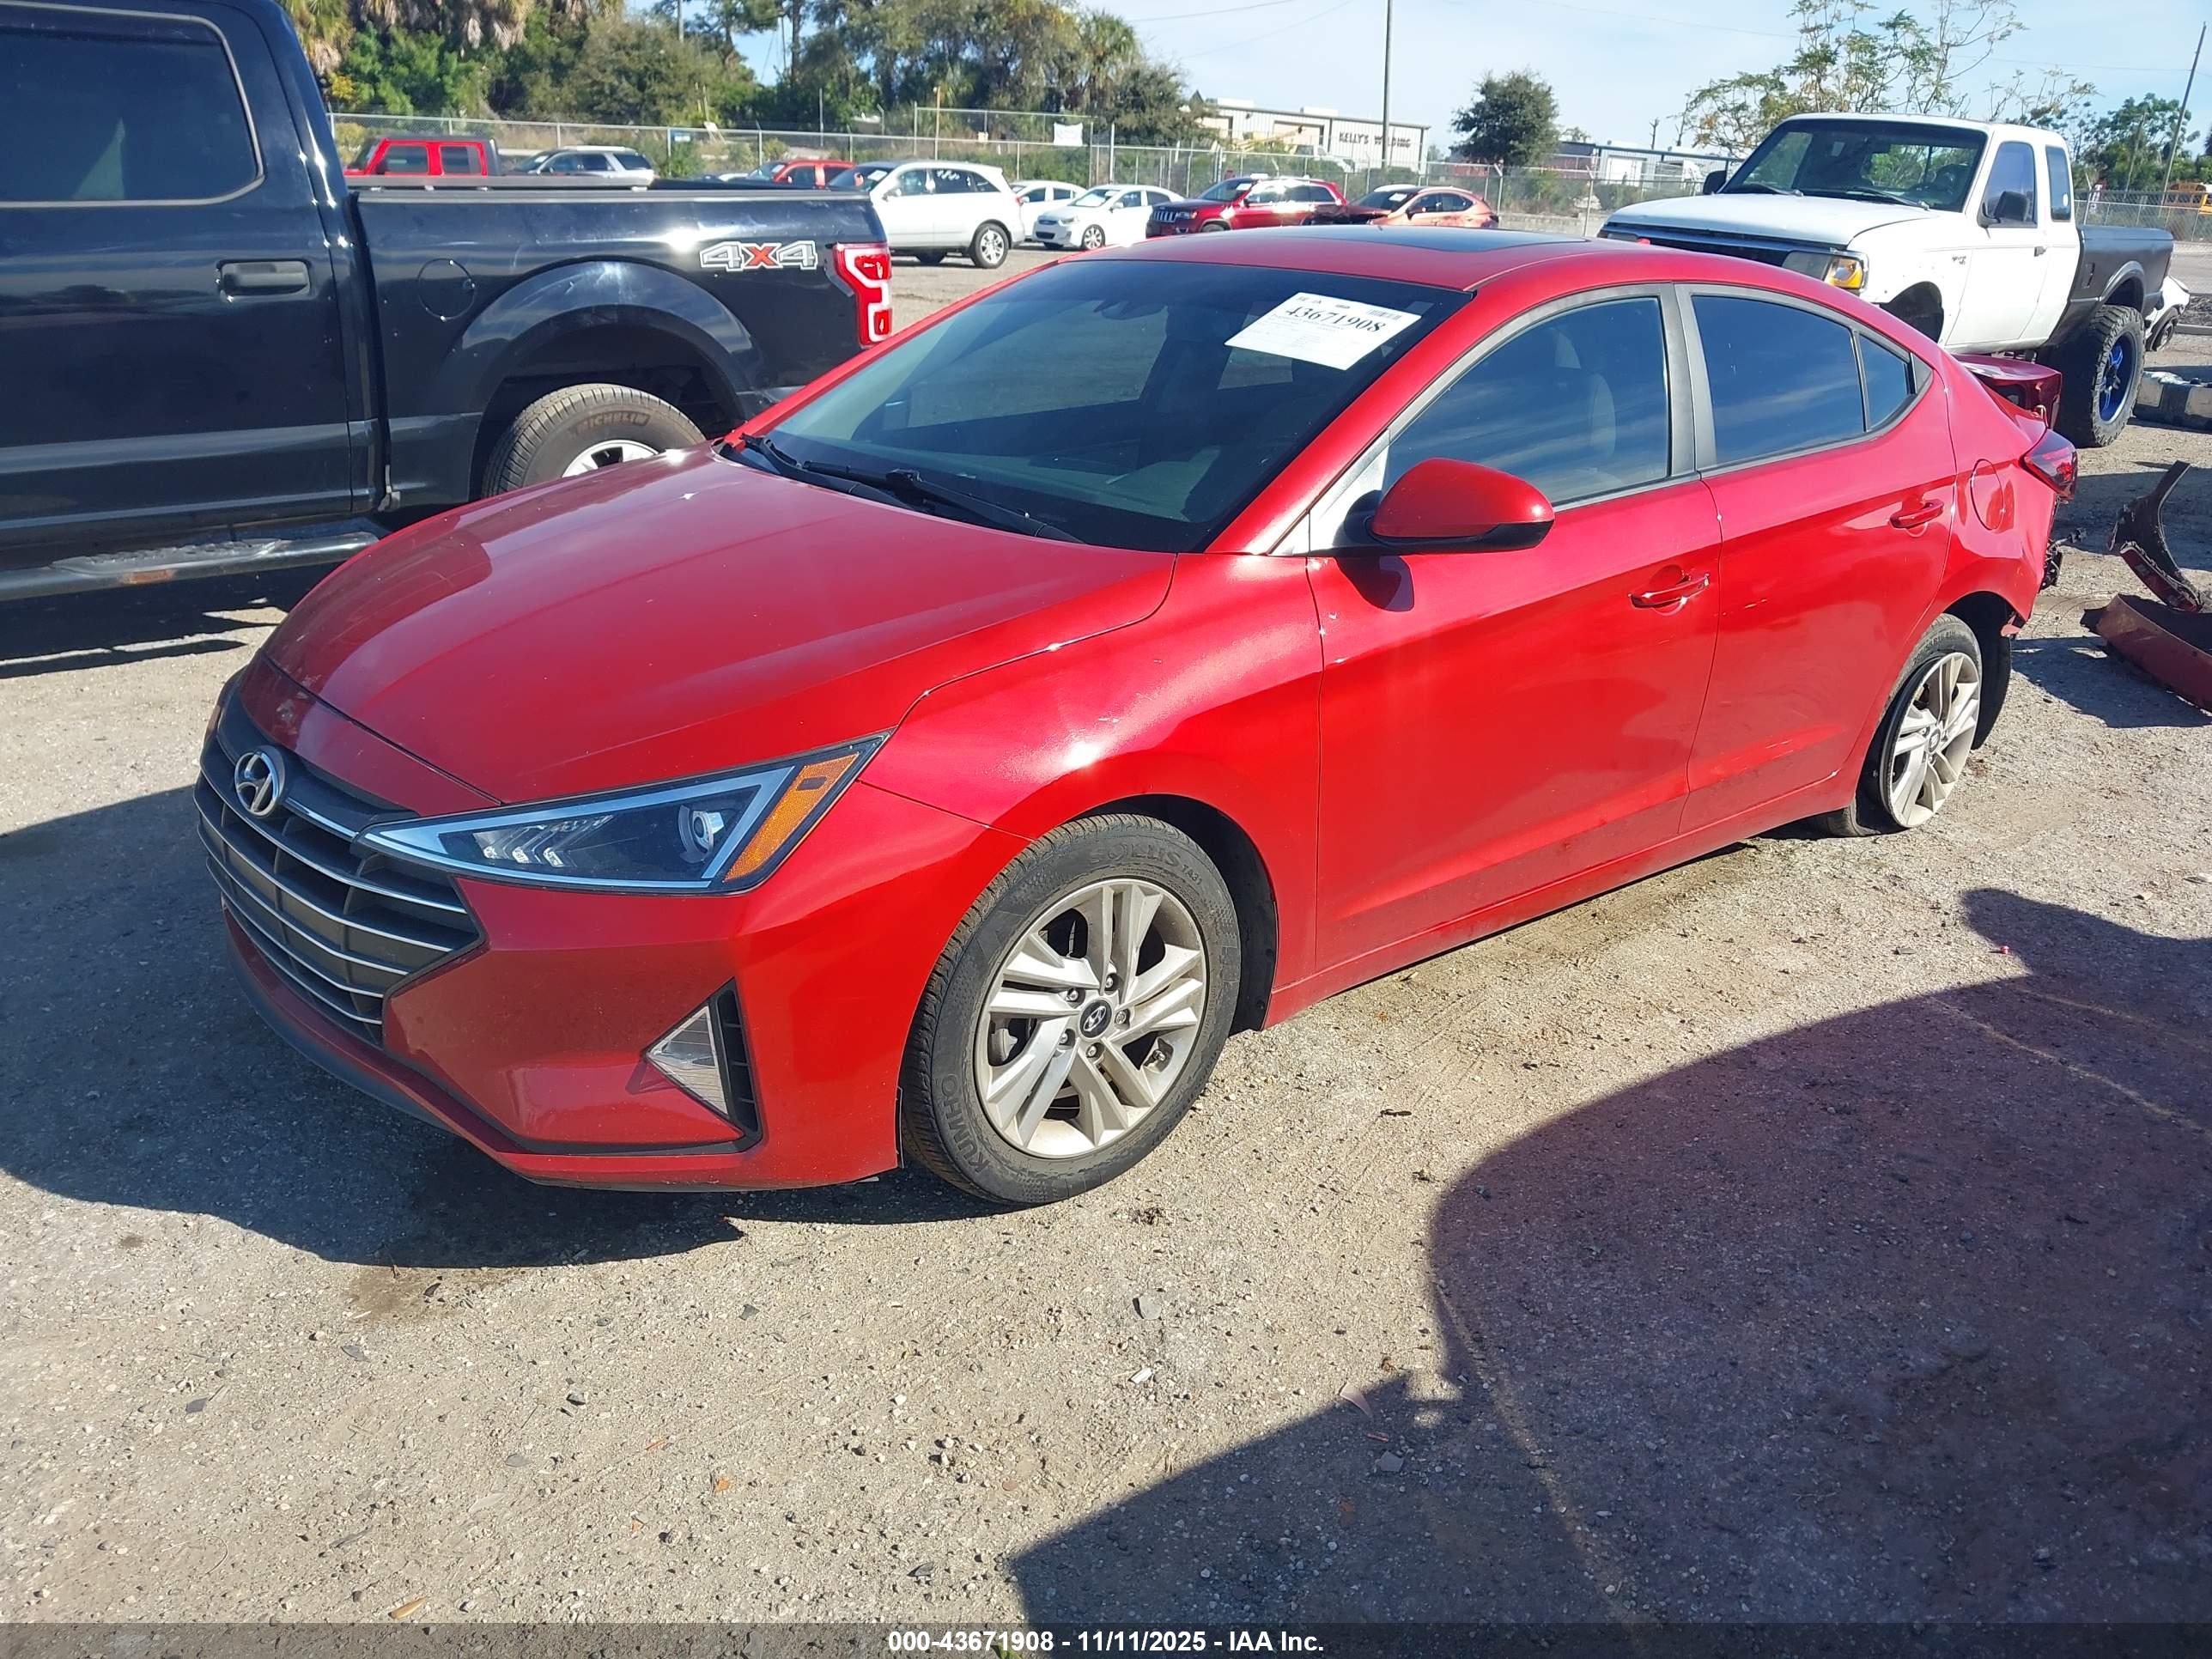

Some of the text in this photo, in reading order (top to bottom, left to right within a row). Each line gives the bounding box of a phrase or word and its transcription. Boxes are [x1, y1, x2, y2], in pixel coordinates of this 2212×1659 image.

[1339, 131, 1411, 149] KELLY'S WLDING
[1285, 306, 1387, 333] 43671908
[940, 1073, 991, 1174] KUMHO
